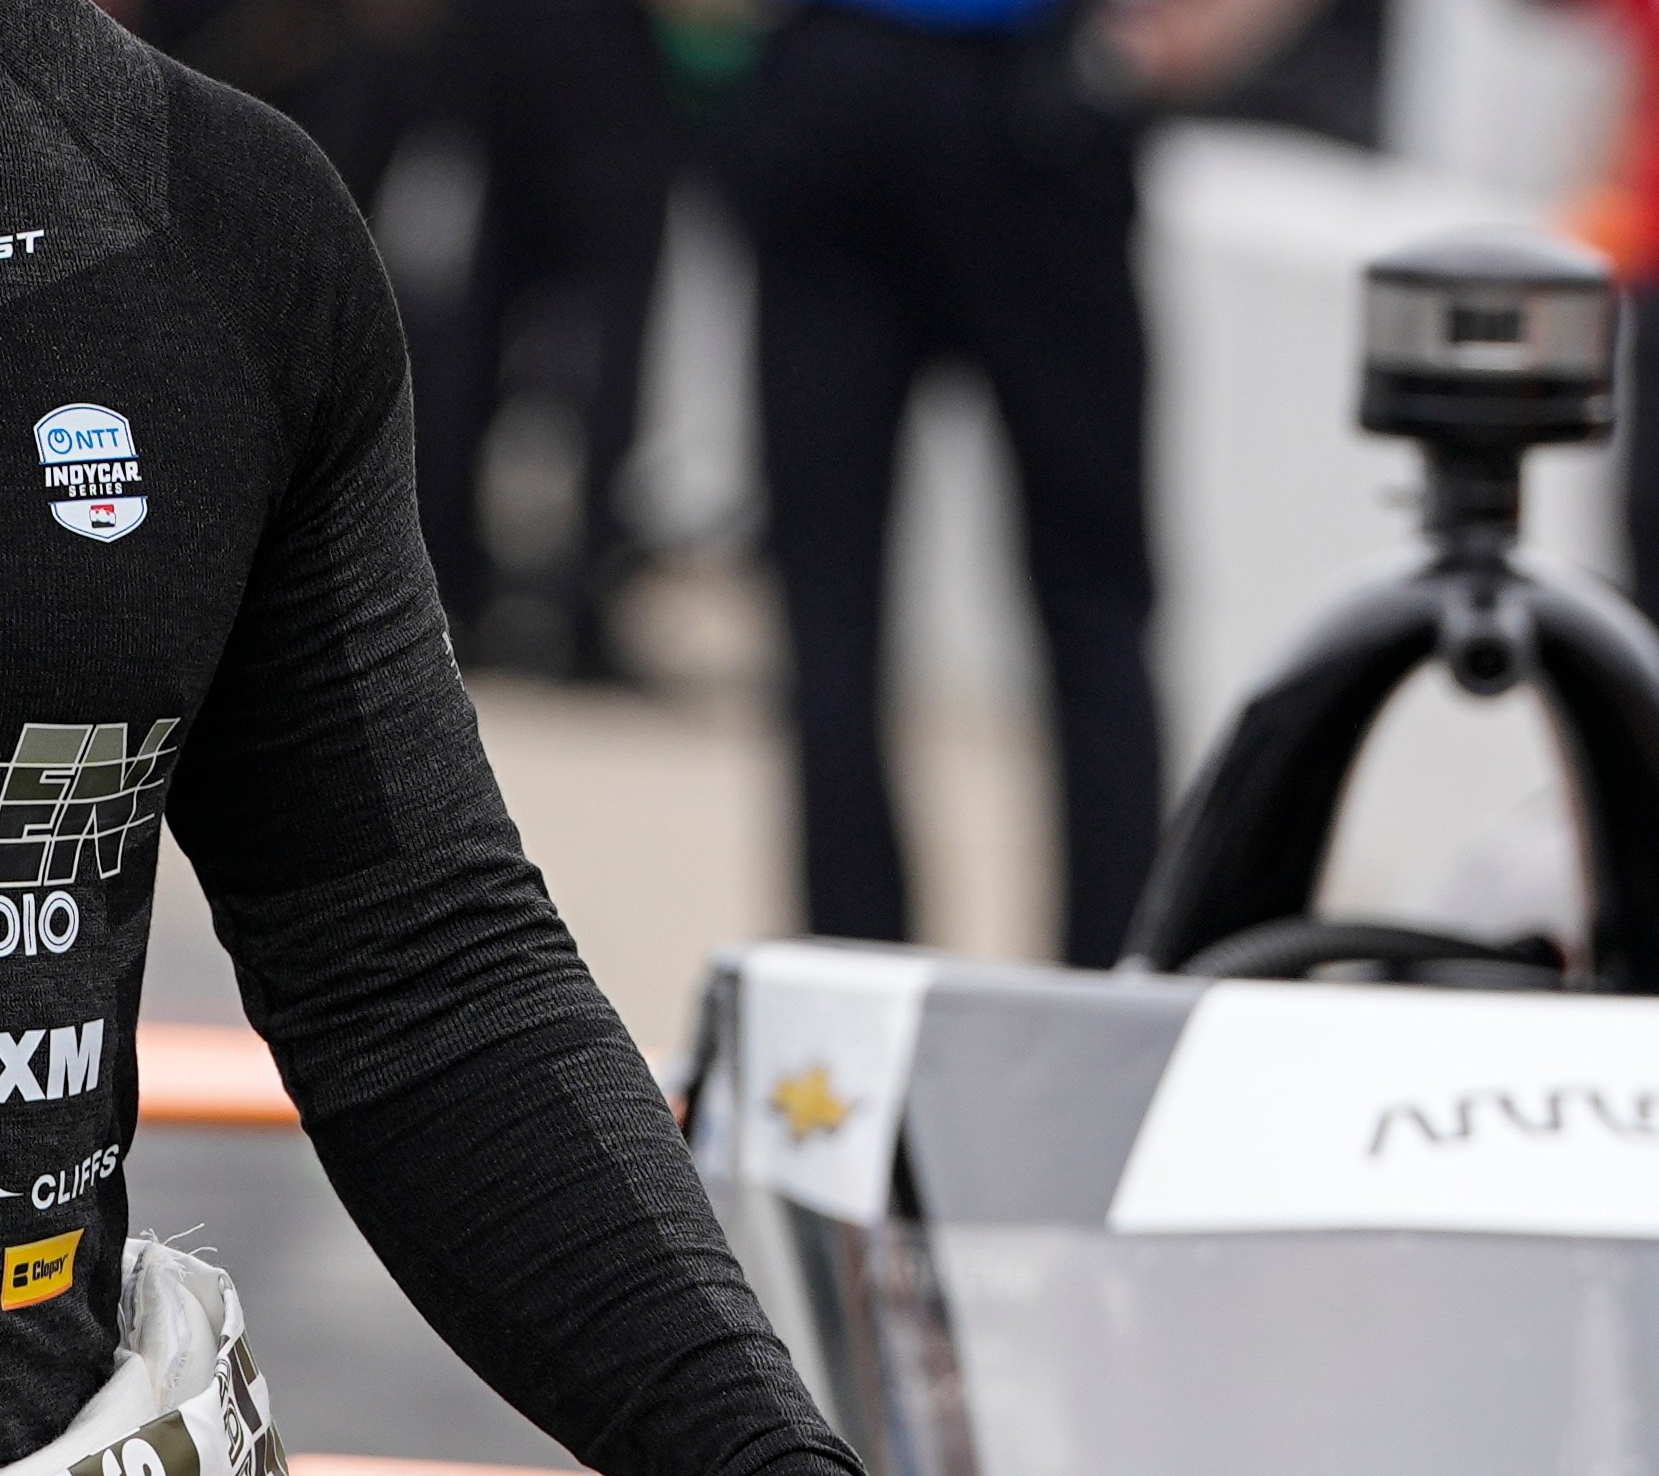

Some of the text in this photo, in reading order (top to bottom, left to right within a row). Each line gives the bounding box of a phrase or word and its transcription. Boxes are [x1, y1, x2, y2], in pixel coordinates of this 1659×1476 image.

[75, 428, 118, 450] NTT
[45, 461, 142, 487] INDYCAR
[69, 482, 122, 497] SERIES
[31, 1143, 120, 1211] CLIFFS
[32, 1255, 66, 1281] Clopay
